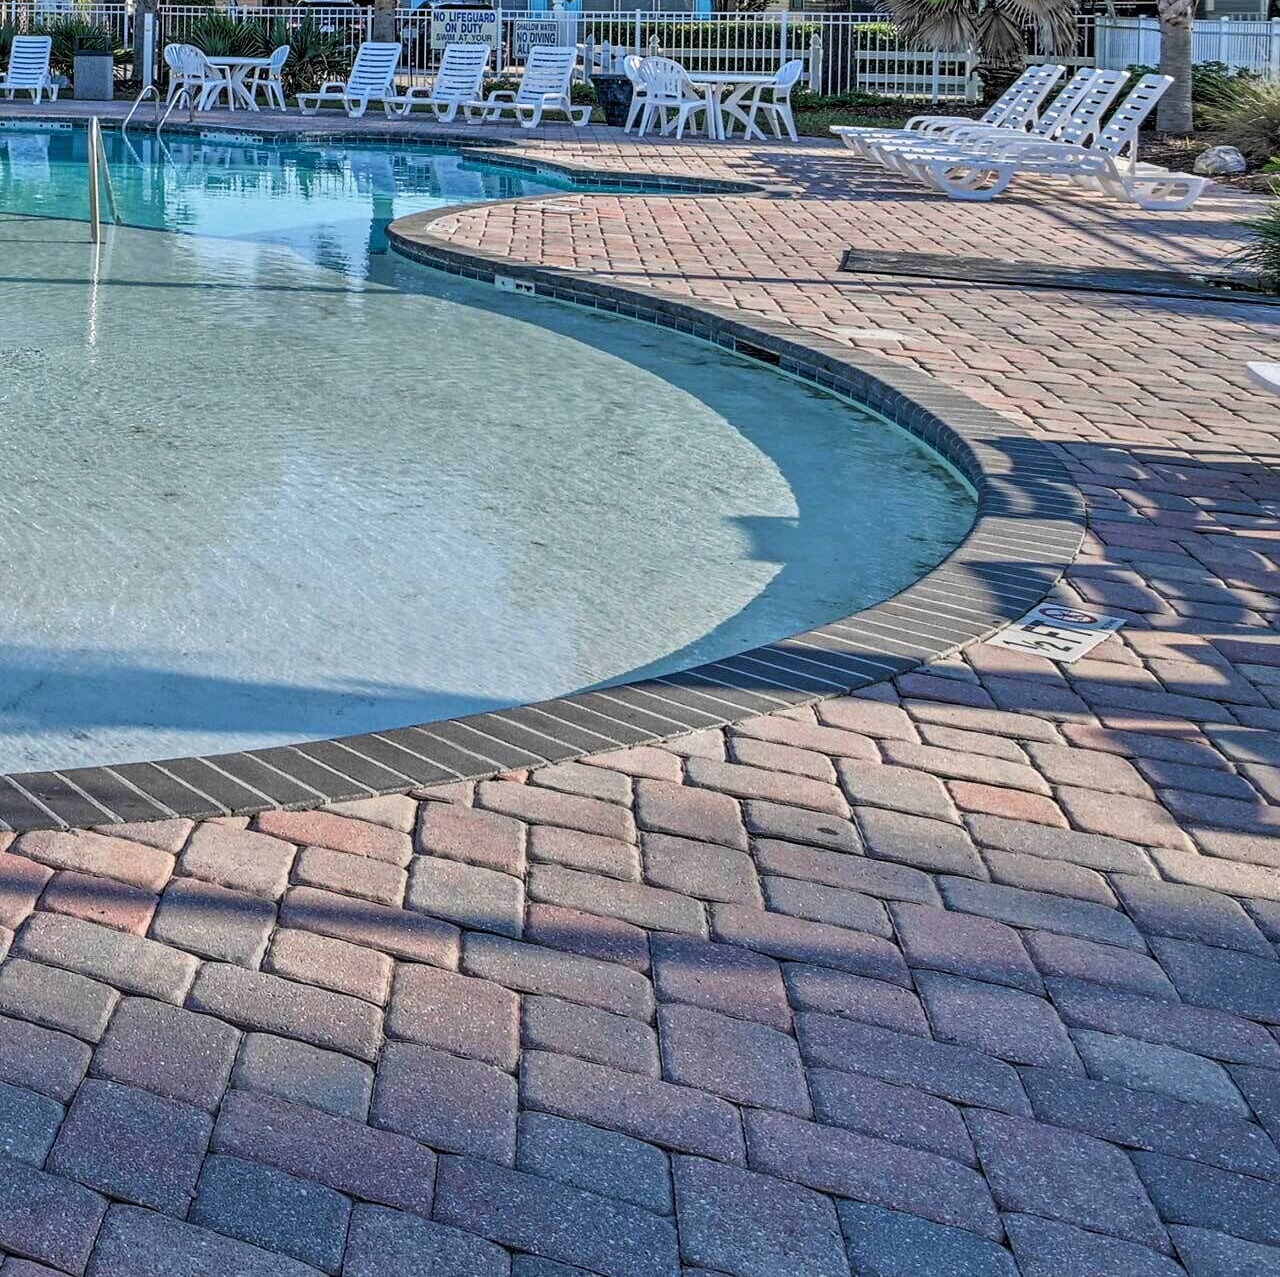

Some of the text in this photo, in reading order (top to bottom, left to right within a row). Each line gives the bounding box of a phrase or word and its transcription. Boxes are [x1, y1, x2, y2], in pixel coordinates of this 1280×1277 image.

[433, 11, 496, 23] NO LIFEGUARD
[445, 23, 483, 33] ON DUTY
[517, 23, 556, 32] SHALLOW WATER
[436, 33, 492, 42] SWIM AT YOUR
[516, 33, 556, 44] NO DIVING
